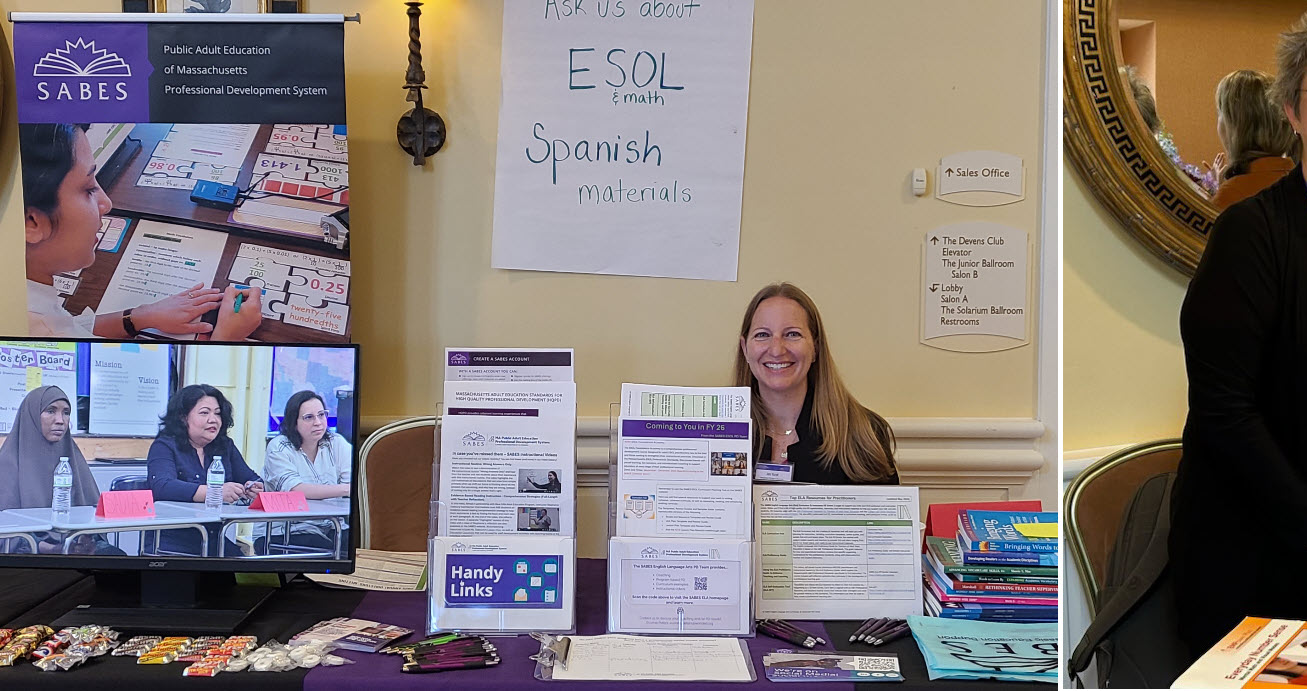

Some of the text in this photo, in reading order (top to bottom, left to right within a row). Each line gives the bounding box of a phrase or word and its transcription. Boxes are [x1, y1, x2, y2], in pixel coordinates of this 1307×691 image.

[545, 0, 586, 20] Ask
[639, 0, 701, 18] about
[163, 45, 271, 56] Public Adult Education
[163, 65, 248, 75] of Massachusetts
[569, 48, 684, 90] ESOL
[37, 82, 128, 101] SABES
[164, 85, 328, 98] Professional Development System
[622, 90, 664, 105] math
[273, 133, 299, 142] 0.95
[525, 122, 662, 185] Spanish
[149, 162, 176, 171] 0.86
[260, 159, 302, 172] 1.413
[320, 166, 343, 175] 1000
[956, 168, 1010, 178] Sales Office
[322, 175, 340, 183] 413
[578, 179, 692, 204] materials
[942, 236, 1005, 245] The Devens Club
[942, 248, 972, 256] Elevator
[942, 259, 1015, 269] The Junior Ballroom
[249, 270, 264, 278] 100
[951, 270, 979, 279] Salon B
[310, 278, 345, 295] 0.25
[941, 284, 964, 294] Lobby
[940, 295, 969, 303] Salon A
[290, 304, 342, 320] twenty-five
[941, 306, 1024, 315] The Solarium Ballroom
[289, 312, 339, 329] hundredths
[940, 317, 980, 326] Restrooms
[0, 352, 70, 366] oster Board
[95, 360, 123, 369] Mission
[645, 422, 674, 431] Coming
[1004, 543, 1030, 551] Bringing
[1032, 543, 1052, 551] Words
[451, 565, 504, 583] Handy
[451, 582, 493, 598] Links
[940, 641, 1058, 655] BES
[1225, 650, 1256, 680] Everyday
[1252, 634, 1274, 658] Number
[1268, 624, 1289, 640] Sense
